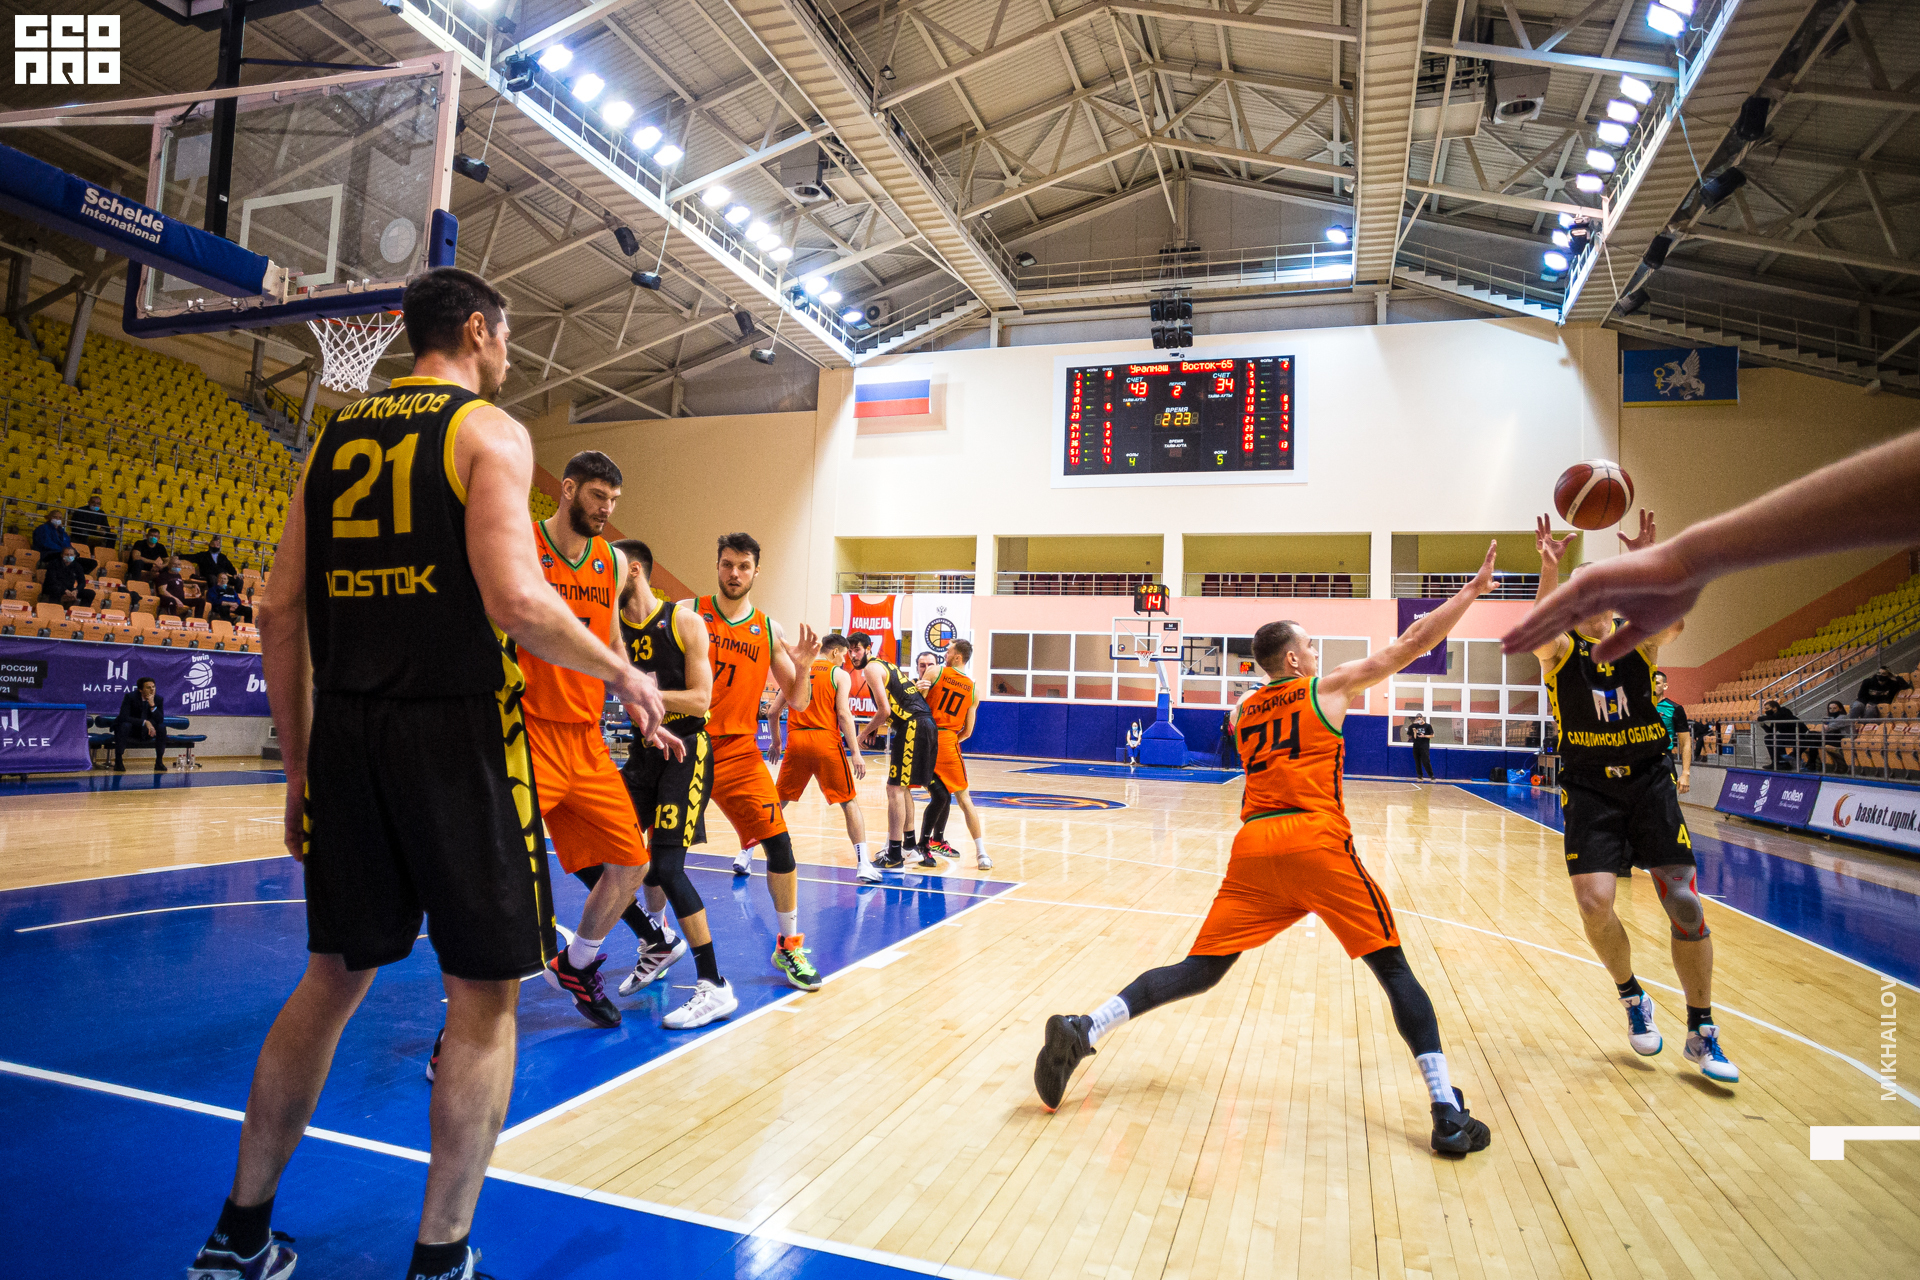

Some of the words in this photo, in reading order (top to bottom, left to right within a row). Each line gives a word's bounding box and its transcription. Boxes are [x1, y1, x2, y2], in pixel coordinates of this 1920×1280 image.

[84, 187, 164, 233] Schelde
[80, 203, 161, 244] International
[1130, 364, 1169, 374] Уралмаш
[1182, 360, 1233, 371] Восток-65
[1130, 381, 1147, 395] 43
[1173, 385, 1181, 396] 2
[1216, 378, 1234, 391] 34
[1246, 404, 1255, 412] 13
[1070, 412, 1080, 420] 23
[1244, 415, 1254, 423] 21
[1070, 431, 1080, 439] 31
[1244, 424, 1254, 432] 23
[1244, 433, 1254, 441] 25
[1244, 442, 1254, 450] 63
[1280, 440, 1289, 449] 13
[1128, 457, 1136, 466] 4
[1216, 454, 1224, 465] 5
[332, 433, 419, 538] 21
[550, 583, 610, 609] АЛМАШ
[1147, 595, 1162, 609] 14
[852, 617, 892, 631] КАНДЕЛЬ
[631, 635, 653, 662] 13
[709, 633, 760, 663] РАЛМАШ
[191, 653, 210, 663] bwin
[1, 664, 38, 673] РОССИИ
[714, 660, 737, 687] 71
[1596, 661, 1615, 677] 4
[246, 674, 267, 693] bw
[942, 675, 972, 692] НОВИКОВ
[182, 686, 217, 705] СУПЕР
[937, 686, 966, 717] 10
[190, 700, 210, 712] ЛИГА
[848, 697, 878, 713] РАЛМ
[1627, 722, 1667, 744] ОБЛАСТЬ
[3, 738, 51, 748] FACE
[1240, 710, 1303, 777] 24
[1781, 789, 1804, 803] molten
[655, 804, 679, 830] 13
[762, 802, 784, 824] 71
[1676, 823, 1692, 849] 4
